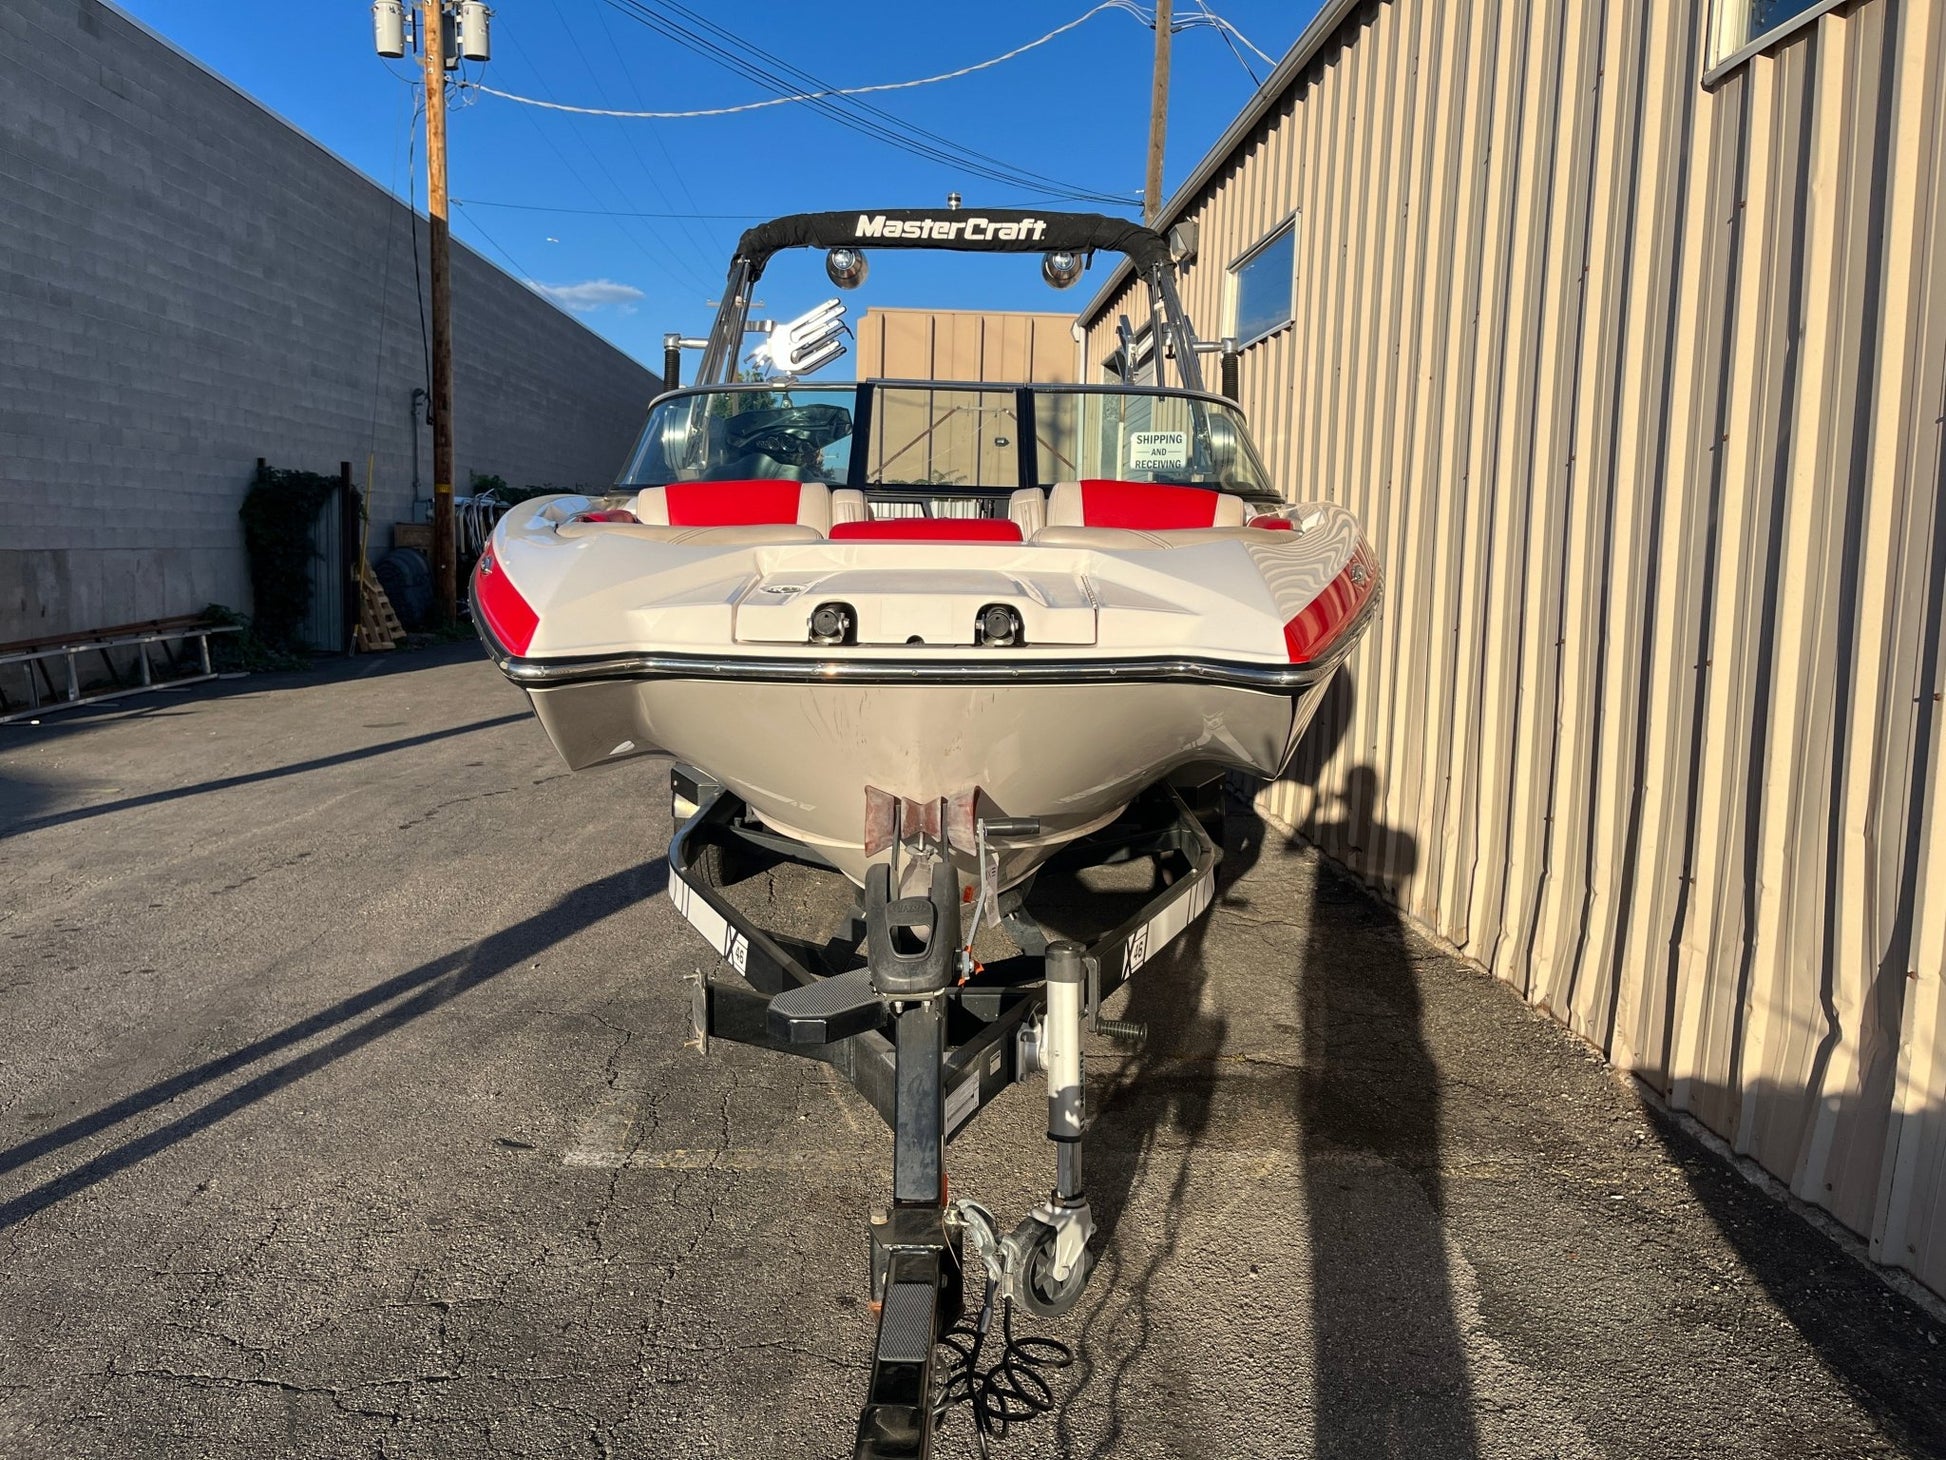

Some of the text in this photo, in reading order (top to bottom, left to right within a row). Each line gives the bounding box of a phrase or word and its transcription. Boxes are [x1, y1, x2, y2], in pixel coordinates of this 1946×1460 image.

[855, 214, 1047, 241] MasterCraft
[1136, 434, 1183, 445] SHIPPING
[1151, 448, 1167, 456] AND
[1135, 459, 1181, 469] RECEIVING
